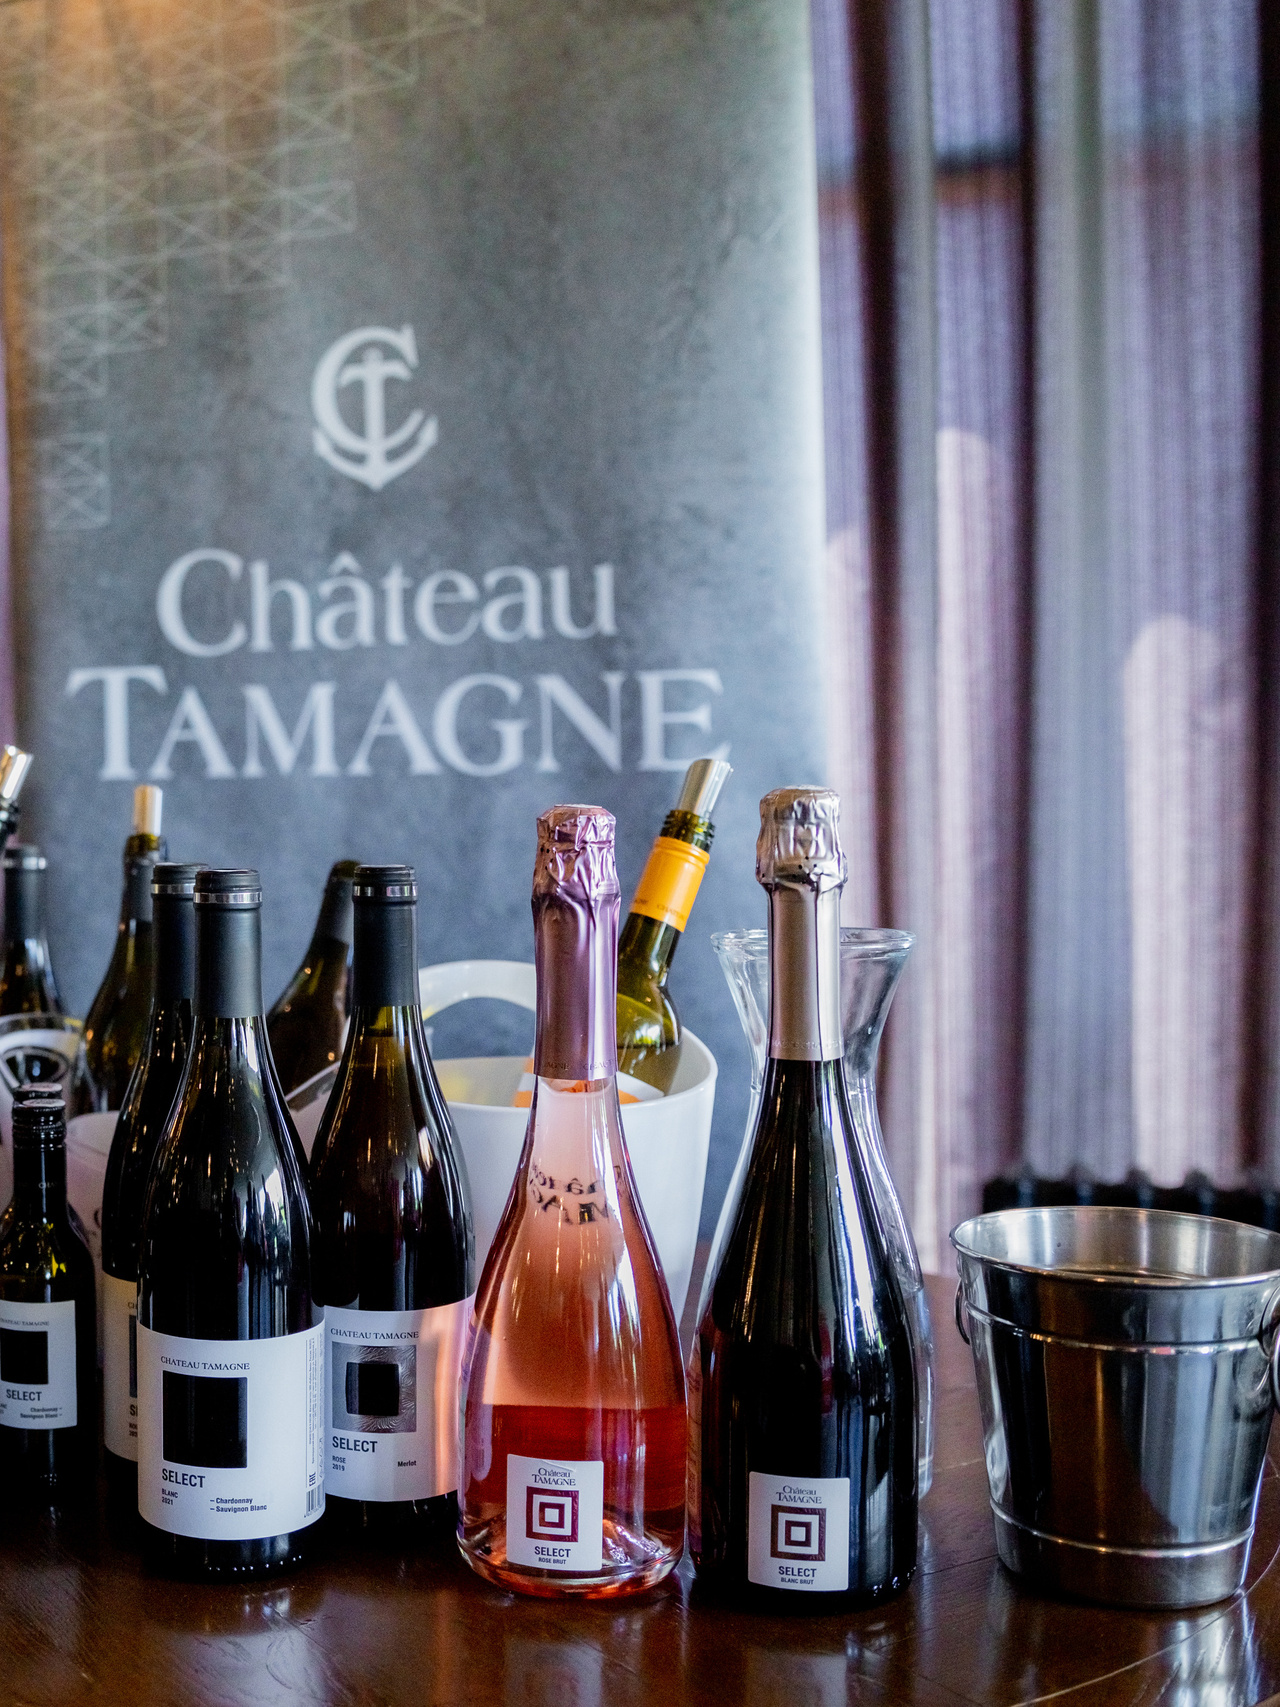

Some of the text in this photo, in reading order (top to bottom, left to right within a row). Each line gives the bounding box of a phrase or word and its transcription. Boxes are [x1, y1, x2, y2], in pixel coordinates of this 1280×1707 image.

[155, 547, 619, 658] Château
[64, 665, 732, 782] TAMAGNE
[330, 1327, 419, 1339] CHATEAU TAMAGNE
[160, 1355, 250, 1370] CHATEAU TAMAGNE
[6, 1388, 42, 1401] SELECT
[332, 1435, 378, 1453] SELECT
[332, 1455, 346, 1464] ROSE
[332, 1463, 345, 1471] 2019
[538, 1467, 571, 1478] Château
[161, 1468, 206, 1488] SELECT
[531, 1473, 576, 1486] TAMAGNE
[161, 1488, 178, 1498] BLANC
[782, 1485, 817, 1495] Château
[776, 1491, 822, 1504] TAMAGNE
[215, 1504, 267, 1513] Sauvignon Blanc
[534, 1545, 571, 1558] SELECT
[538, 1556, 551, 1564] ROSE
[778, 1565, 817, 1578] SELECT
